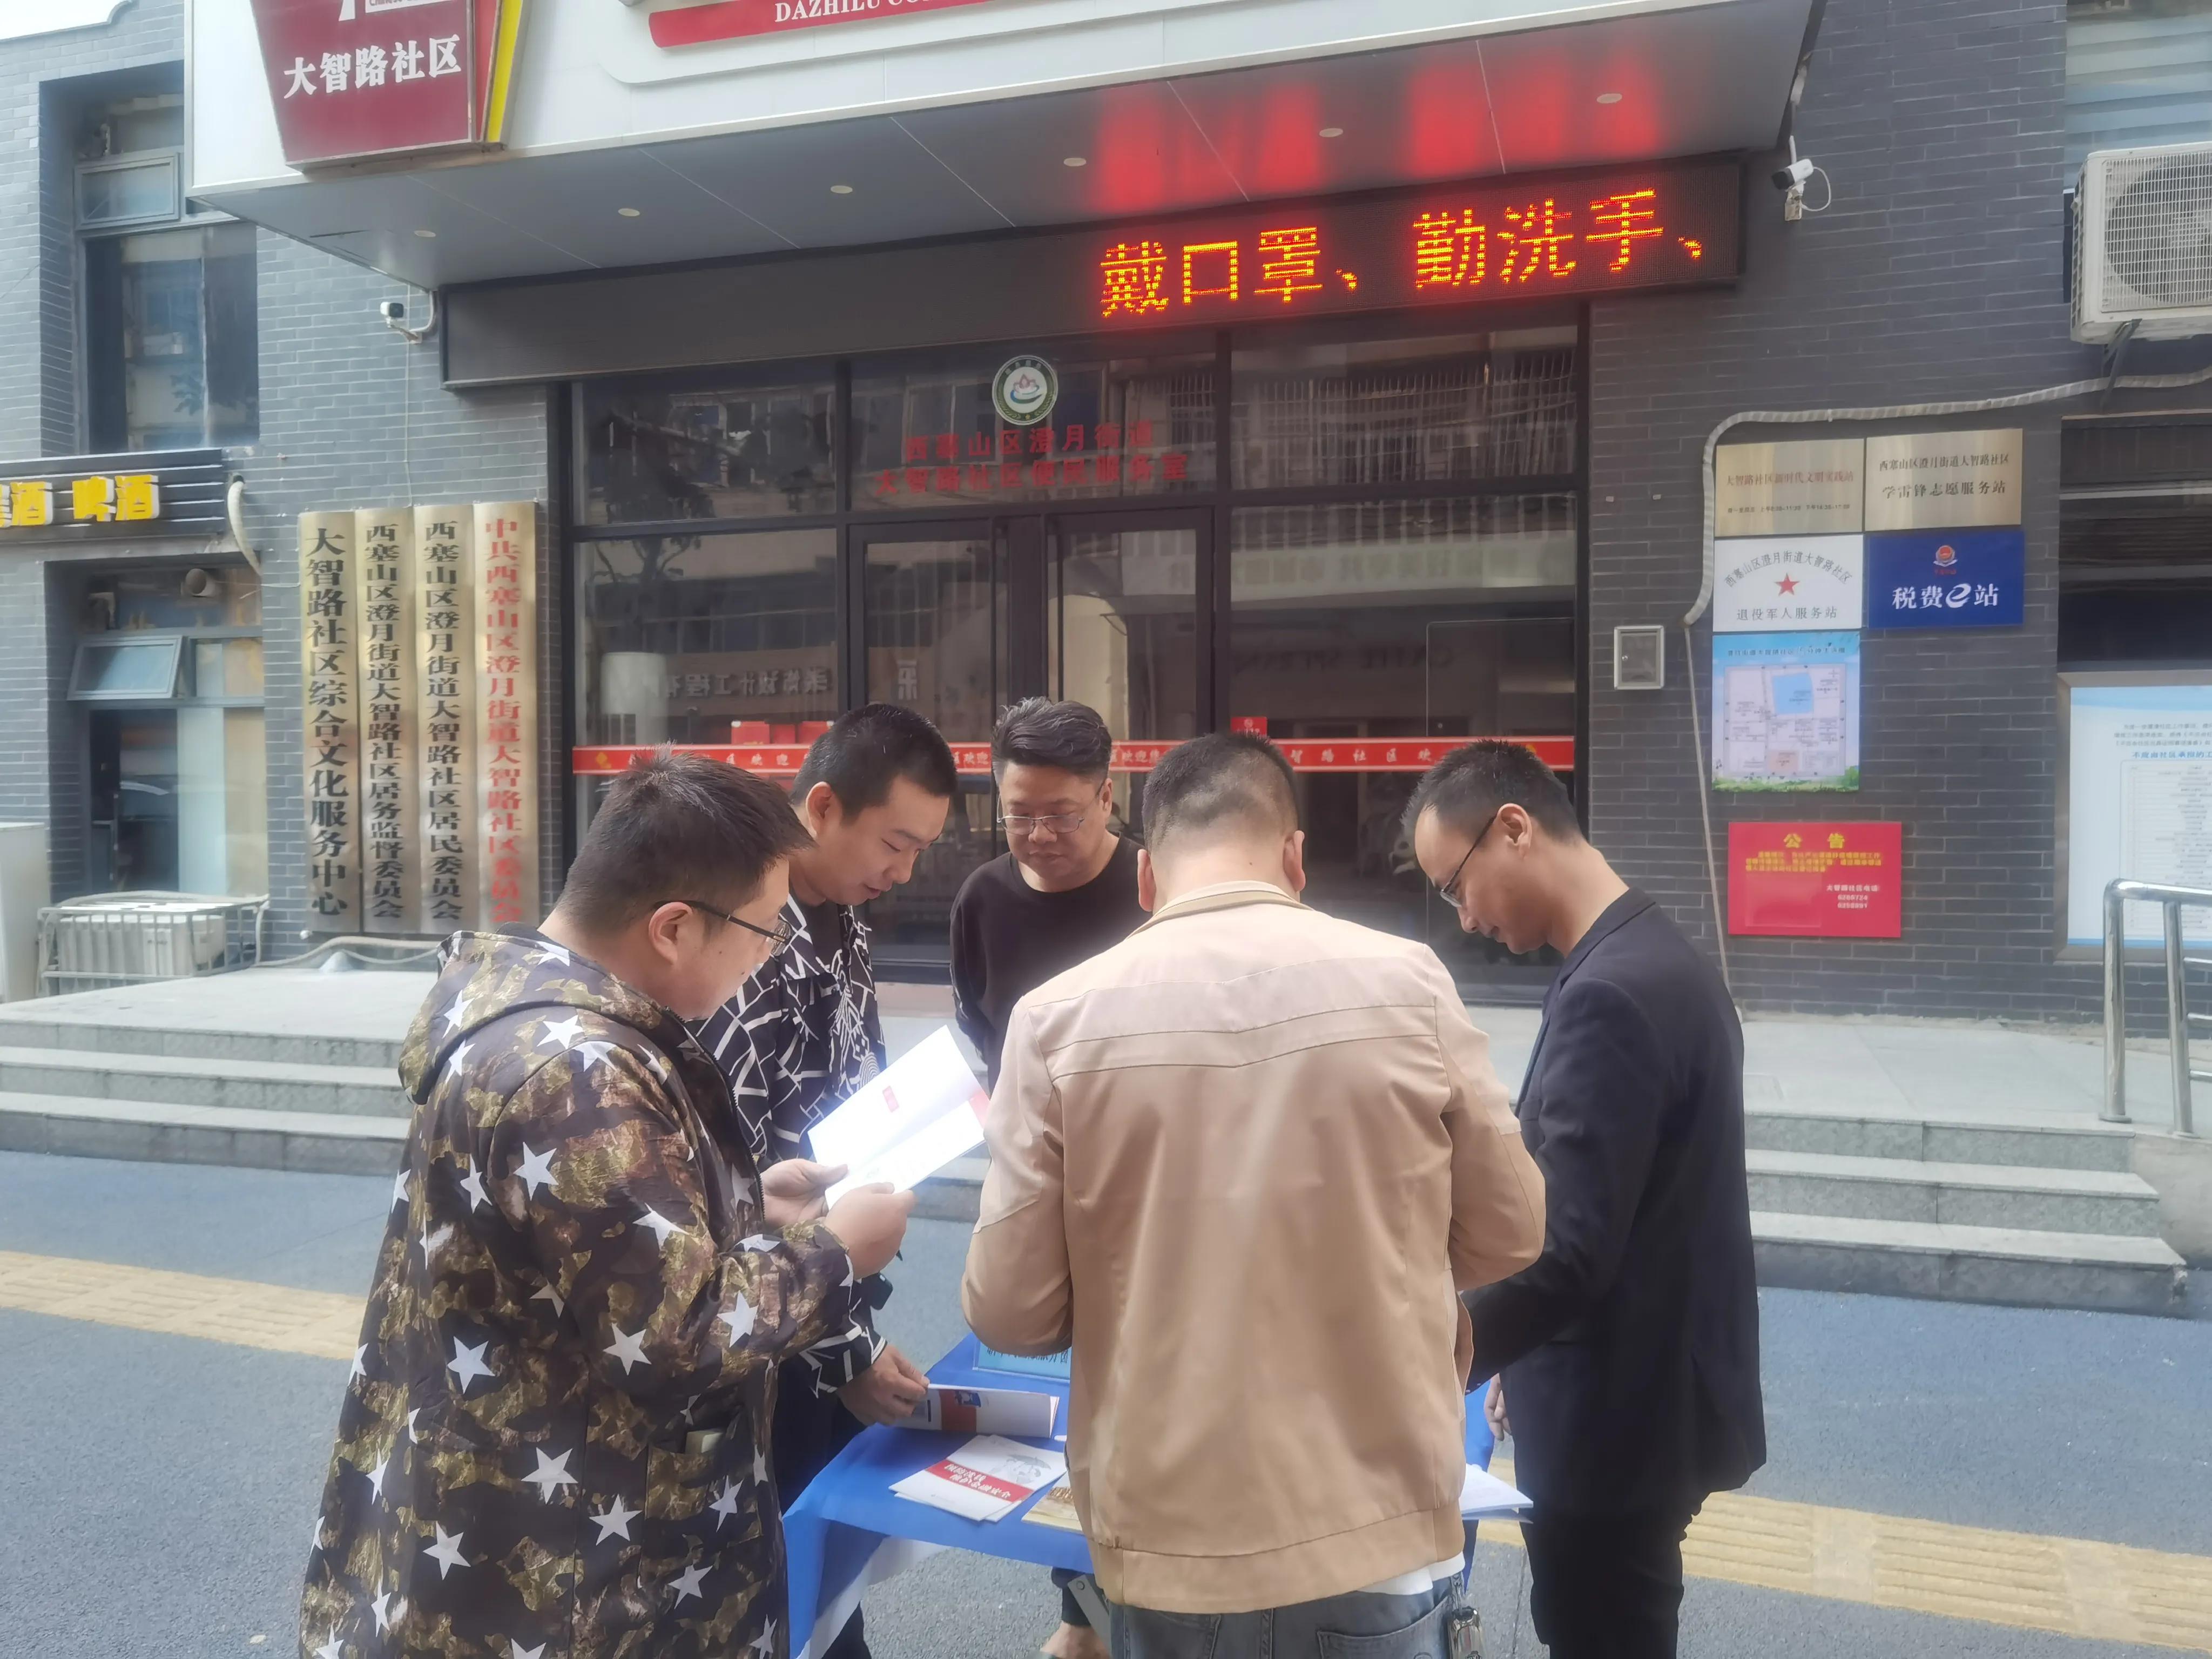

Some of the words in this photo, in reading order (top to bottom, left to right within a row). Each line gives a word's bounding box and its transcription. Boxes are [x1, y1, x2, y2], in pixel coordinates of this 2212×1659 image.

[283, 34, 462, 99] 大智路社区
[1879, 453, 2008, 471] 西塞山区澄月街道大智路社区
[1883, 480, 2006, 499] 学雷锋志愿服务站
[0, 482, 53, 528] 酒
[1724, 550, 1853, 588] 西塞山区澄月街道大智路社区
[1736, 605, 1838, 622] 退役军人服务站
[306, 528, 349, 916] 大智路社区综合文化服务中心
[365, 523, 404, 918] 西塞山区澄月街道大智路社区居务监督委员会
[423, 521, 464, 920] 西塞山区澄月街道大智路社区居民委员会
[485, 518, 523, 922] 中共西塞山区澄月街道大智路社区委员会
